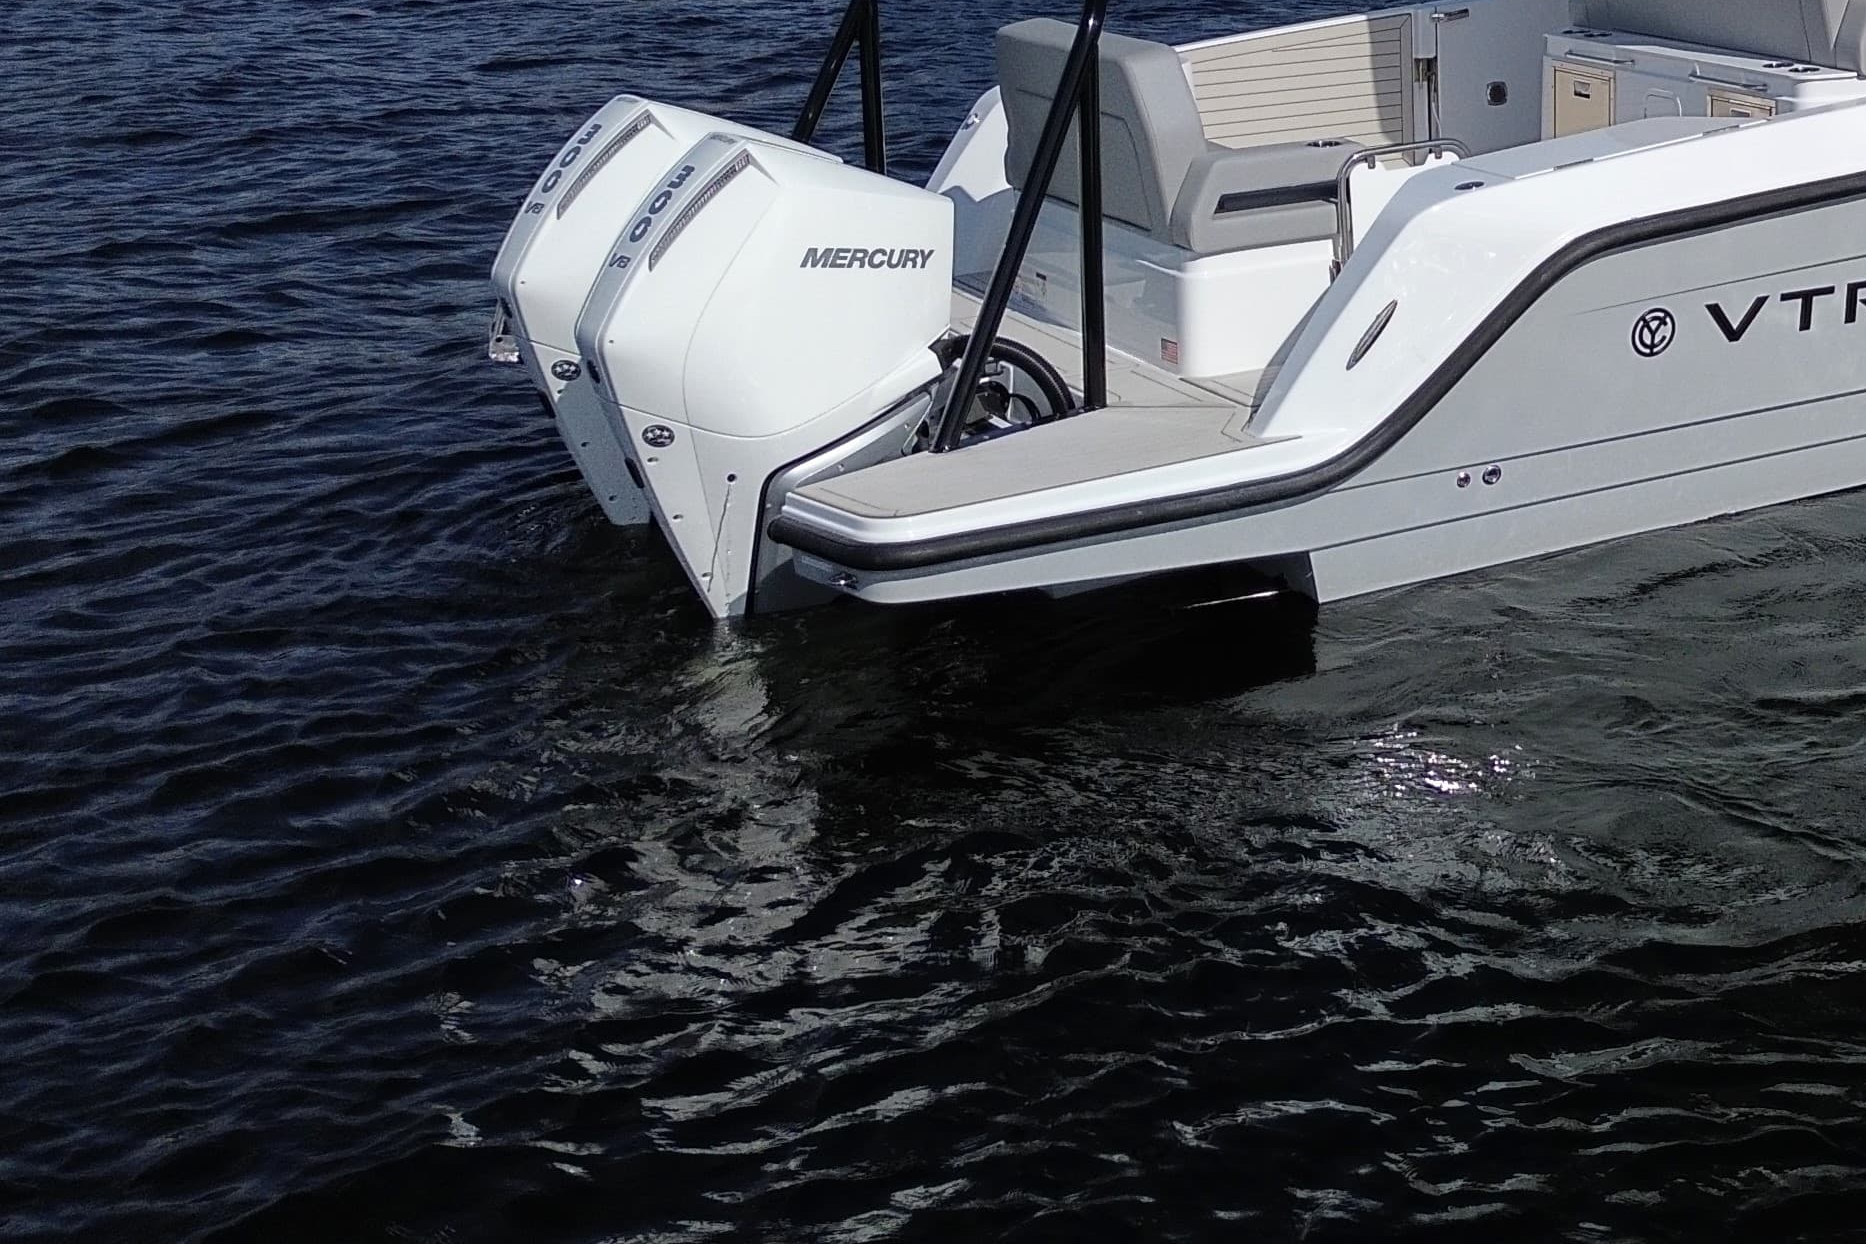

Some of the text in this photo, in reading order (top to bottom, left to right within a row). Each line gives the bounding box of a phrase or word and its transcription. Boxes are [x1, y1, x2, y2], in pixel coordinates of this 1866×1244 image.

[541, 123, 602, 193] 300
[630, 165, 695, 243] 300
[800, 247, 935, 269] MERCURY
